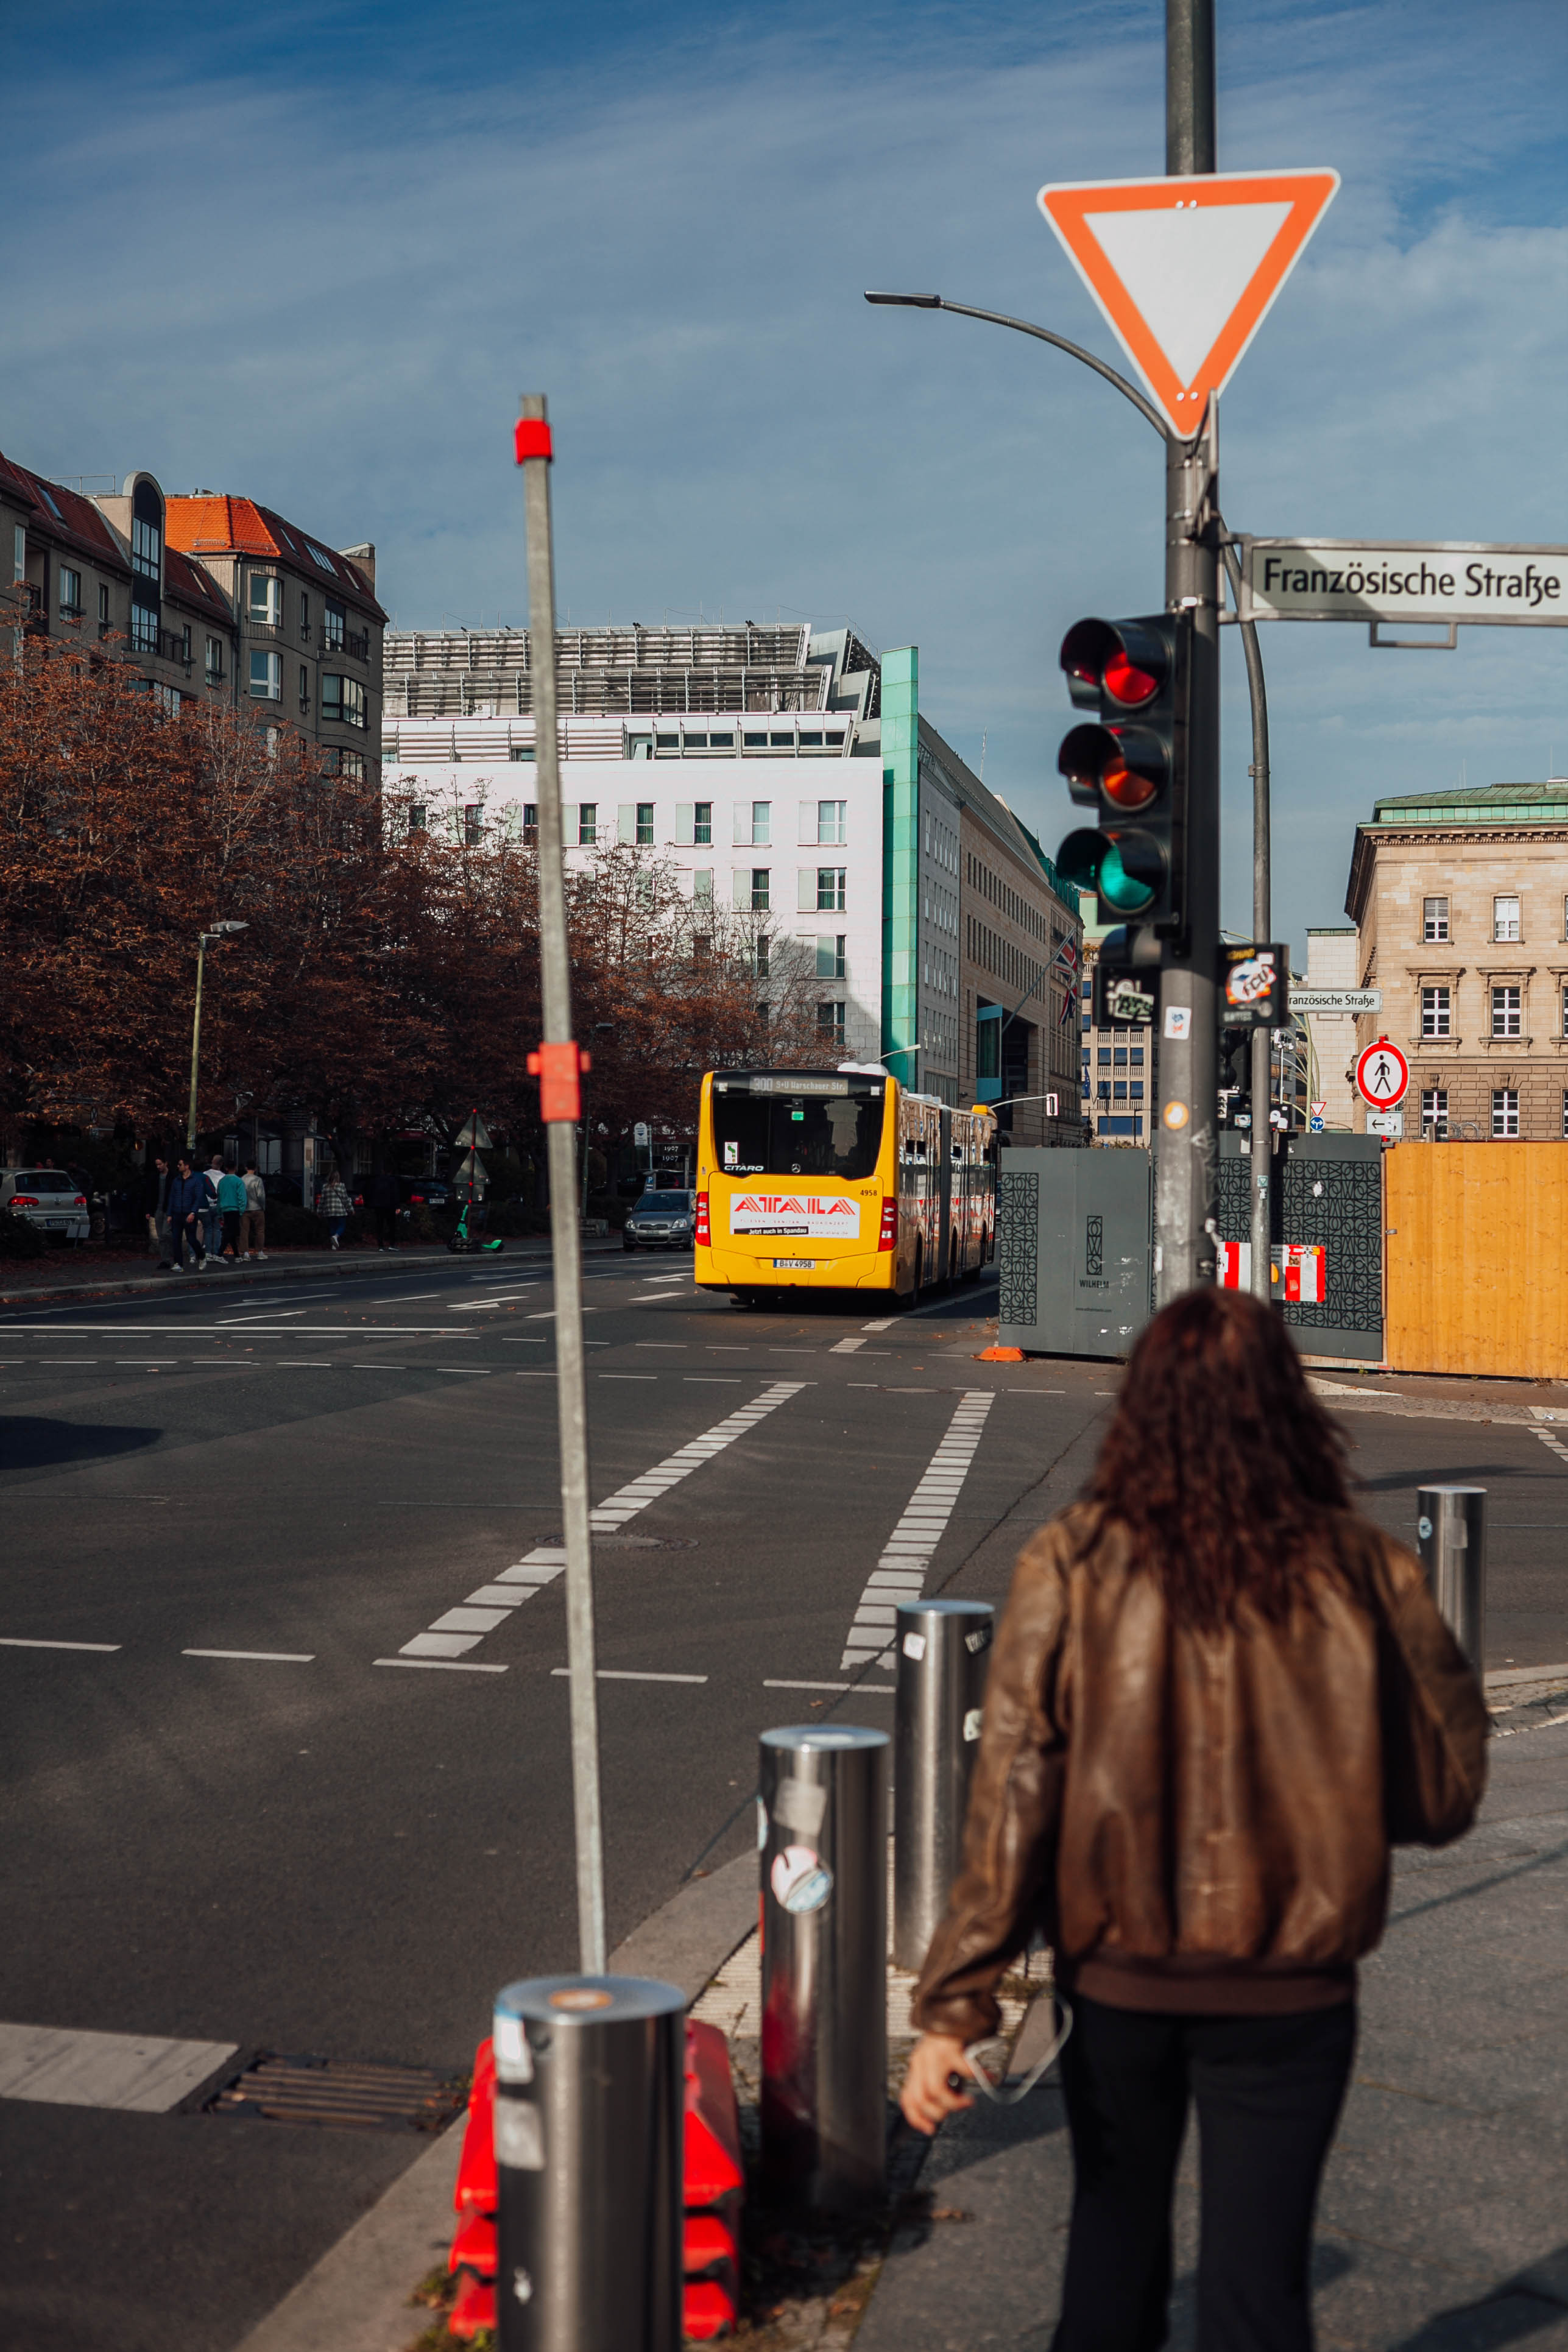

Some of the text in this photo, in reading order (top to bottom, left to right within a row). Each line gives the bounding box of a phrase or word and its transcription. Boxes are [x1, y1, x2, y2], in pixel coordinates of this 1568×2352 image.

[1263, 557, 1561, 607] Französische Straße
[1288, 994, 1375, 1008] ranzösische Straße
[754, 1078, 773, 1092] 300
[791, 1081, 829, 1090] Warschauer
[831, 1081, 846, 1090] Str.
[734, 1196, 856, 1216] ATALA
[1079, 1279, 1109, 1289] WILHELM
